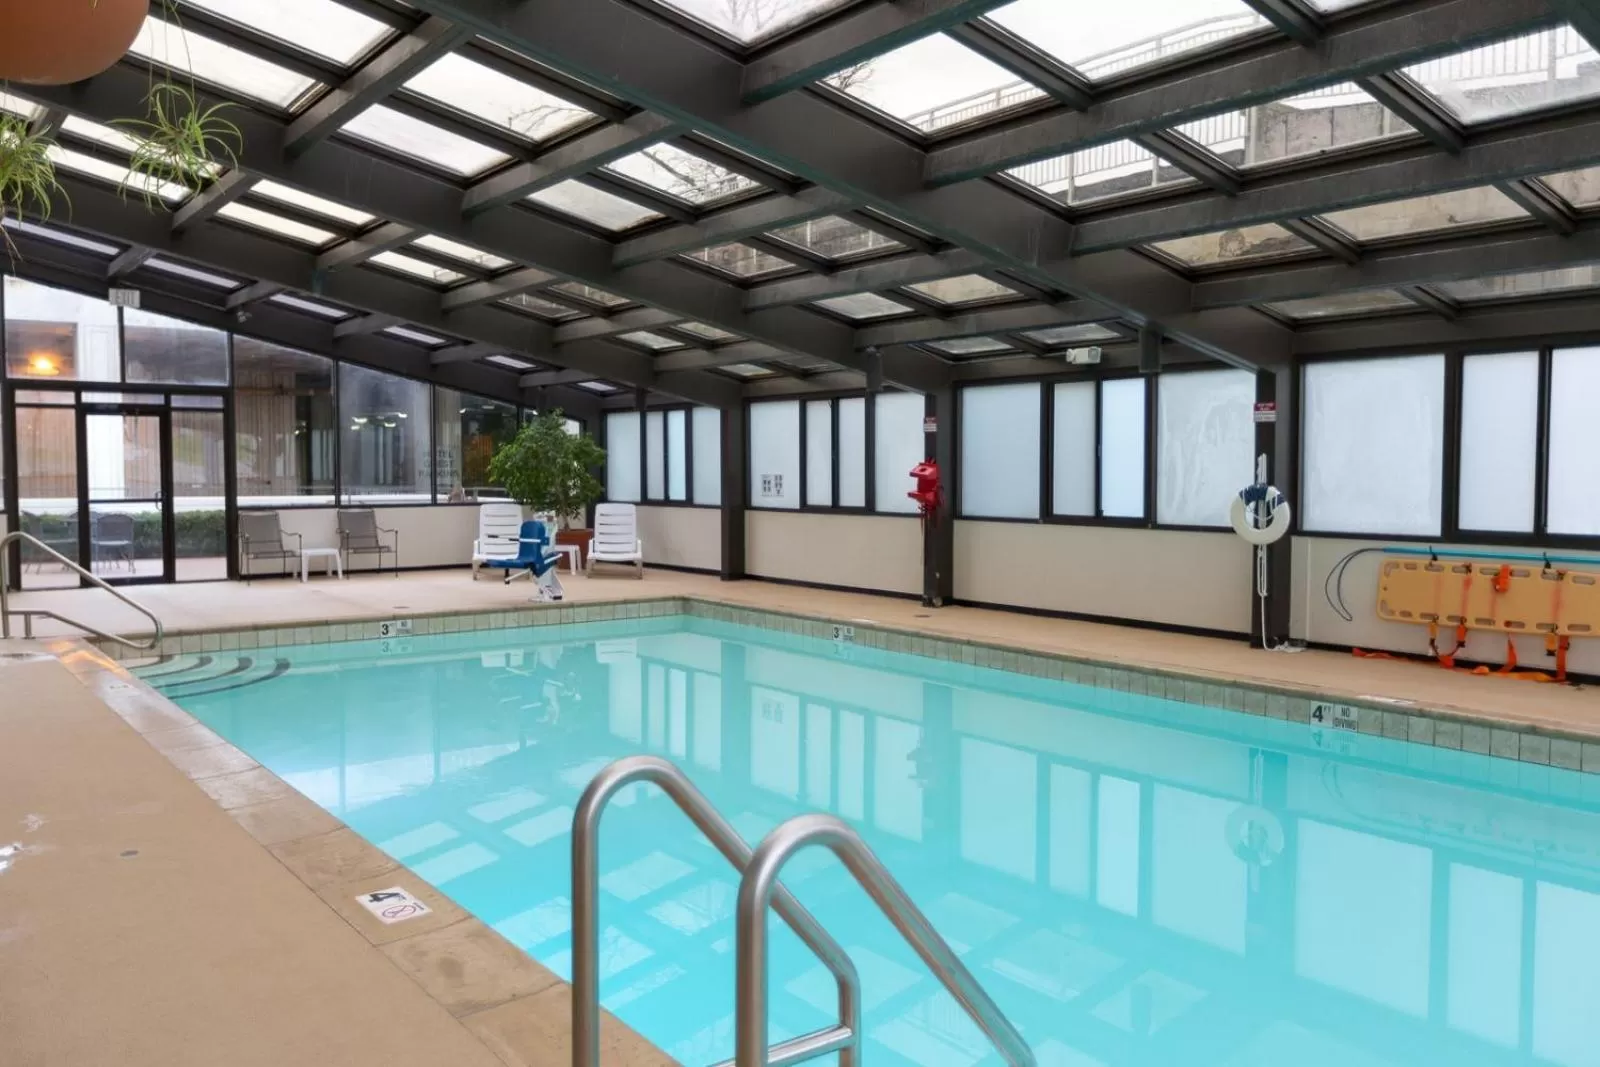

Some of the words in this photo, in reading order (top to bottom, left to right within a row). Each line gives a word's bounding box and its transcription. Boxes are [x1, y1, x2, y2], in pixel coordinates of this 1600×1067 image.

[381, 623, 390, 636] 3
[833, 626, 840, 639] 3
[1312, 705, 1324, 723] 4
[368, 892, 401, 903] 4
